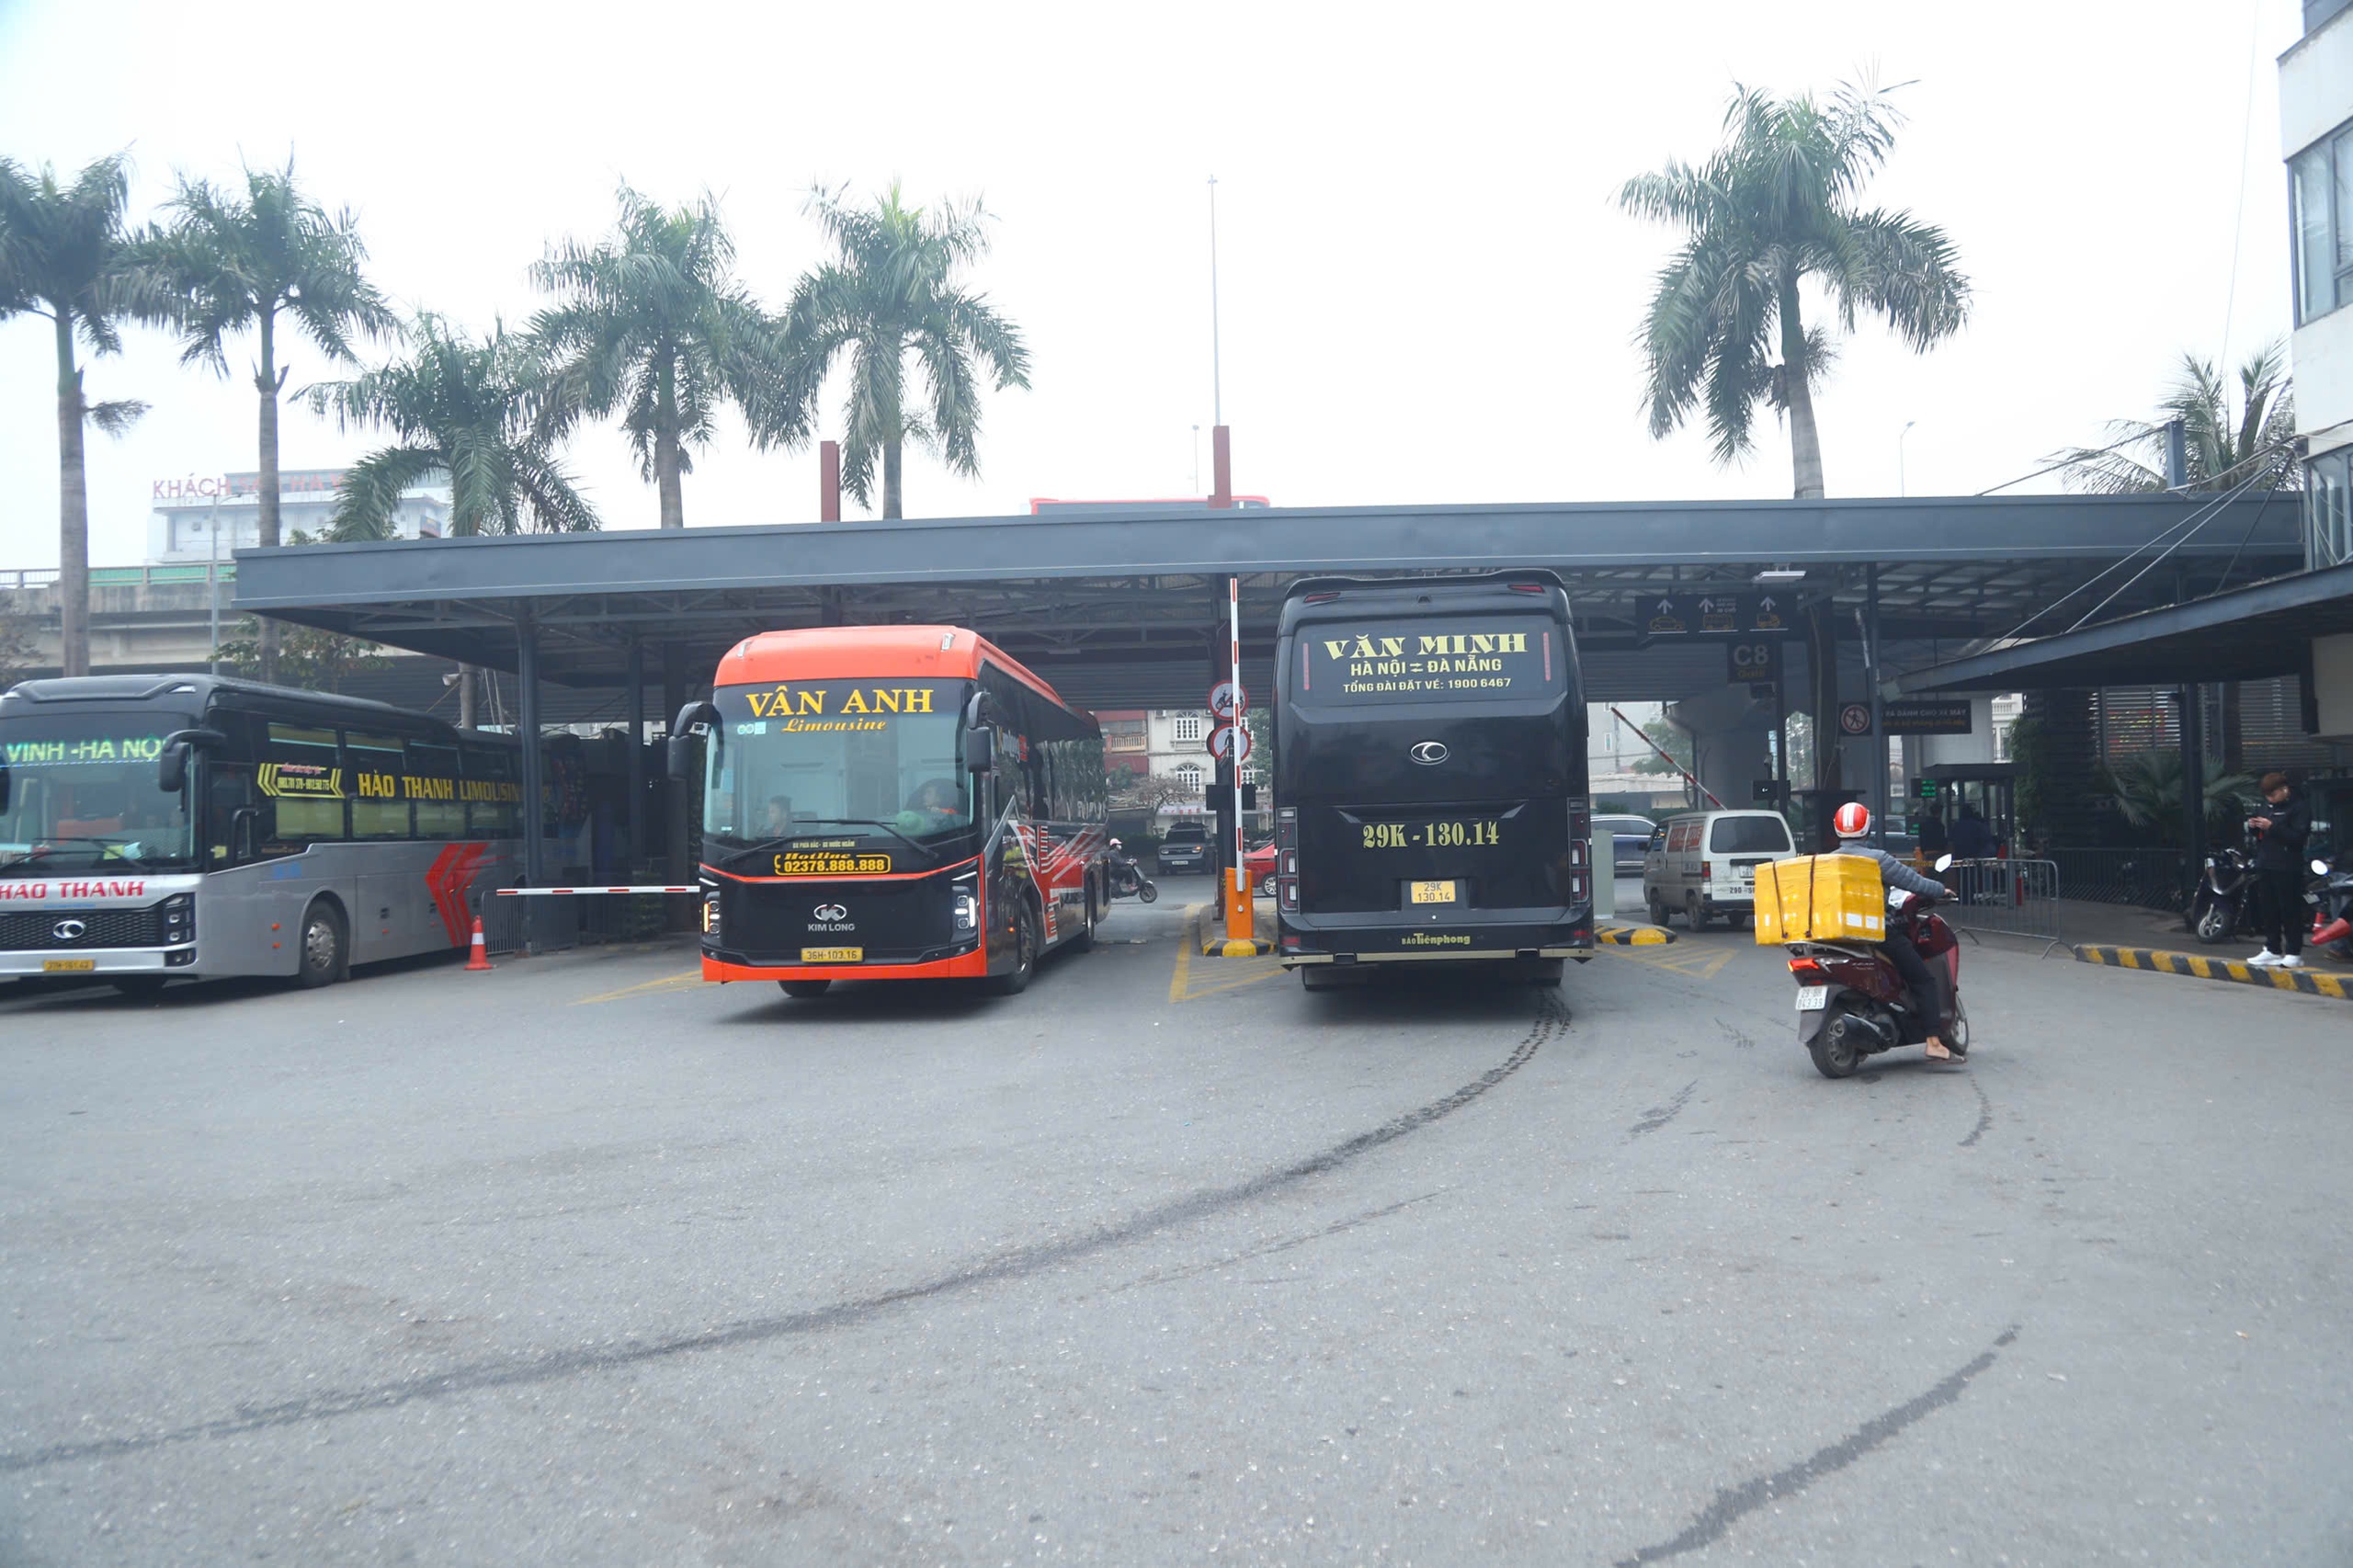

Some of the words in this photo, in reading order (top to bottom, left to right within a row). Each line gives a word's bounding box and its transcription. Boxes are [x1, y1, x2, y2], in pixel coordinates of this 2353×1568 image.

[153, 473, 231, 499] KHÁCH
[1324, 633, 1406, 660] VĂN
[1417, 633, 1529, 655] MINH
[1733, 645, 1769, 665] C8
[1350, 661, 1373, 676] HÀ
[1378, 659, 1406, 677] NỘI
[1427, 658, 1450, 673] ĐÀ
[1455, 653, 1502, 672] NẴNG
[1343, 680, 1373, 693] TỔNG
[1376, 680, 1396, 691] ĐÀI
[1399, 679, 1421, 691] ĐẶT
[1425, 677, 1444, 690] VÉ:
[1448, 678, 1478, 689] 1900
[1480, 677, 1511, 688] 6467
[745, 686, 826, 717] VÂN
[840, 689, 934, 713] ANH
[782, 718, 887, 733] Limousine
[6, 740, 65, 762] VINH
[122, 733, 168, 761] NỘ
[358, 769, 395, 797] HÀO
[402, 777, 454, 800] THANH
[460, 779, 523, 801] LIMOUSIN
[1363, 824, 1407, 847] 29K
[1425, 821, 1499, 846] 130.14
[784, 852, 851, 860] Hotline
[784, 859, 884, 872] 02378.888.888
[59, 881, 145, 898] THANH
[1418, 892, 1450, 902] 130.14
[1425, 882, 1441, 892] 29K
